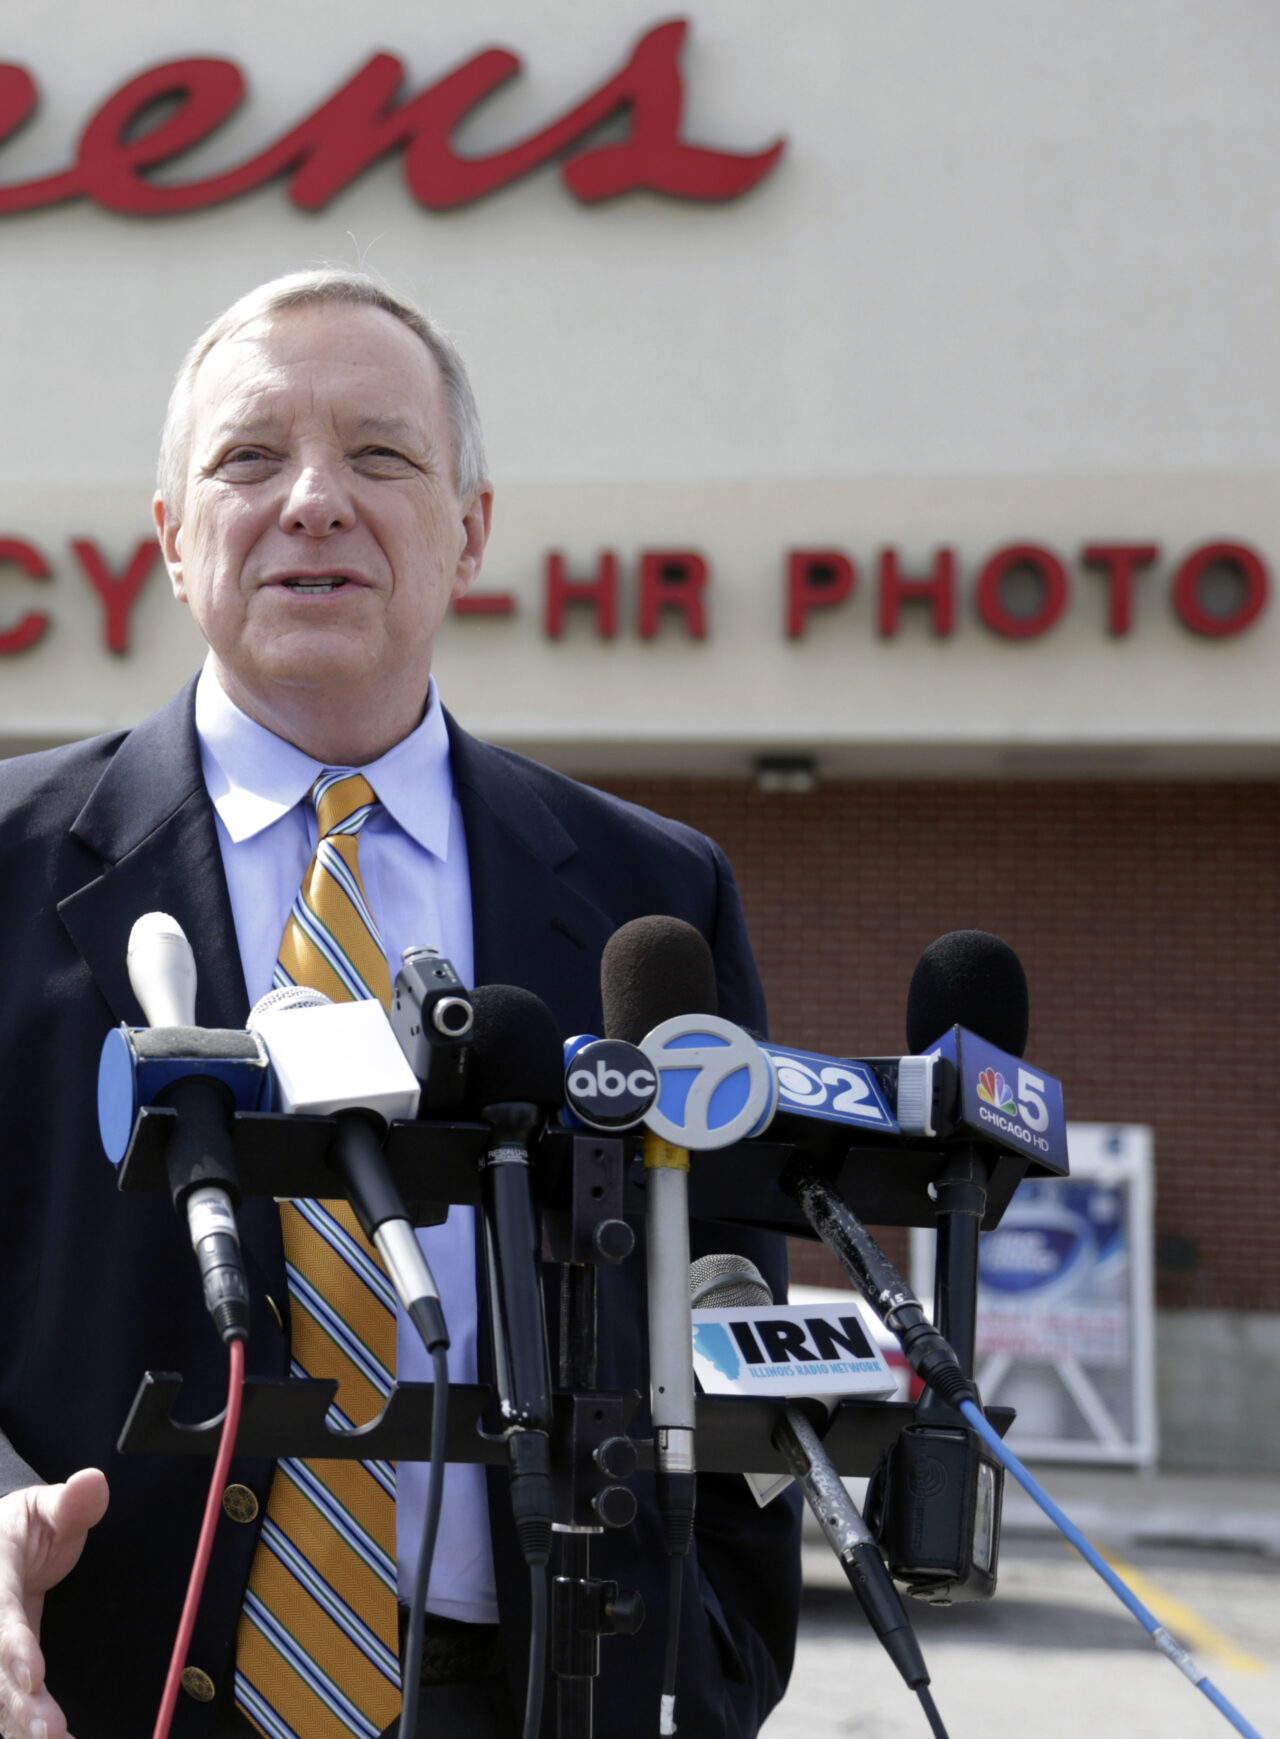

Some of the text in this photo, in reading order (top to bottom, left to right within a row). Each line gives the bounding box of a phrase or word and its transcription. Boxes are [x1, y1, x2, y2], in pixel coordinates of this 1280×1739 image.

[786, 542, 1270, 640] PHOTO
[568, 1061, 656, 1098] abc
[645, 1040, 760, 1145] 7
[820, 1067, 883, 1119] 2
[1017, 1068, 1049, 1133] 5
[979, 1106, 1049, 1152] CHICAGO HD
[729, 1316, 876, 1365] IRN
[749, 1361, 883, 1378] ILLINOIS RADIO NETWORK
